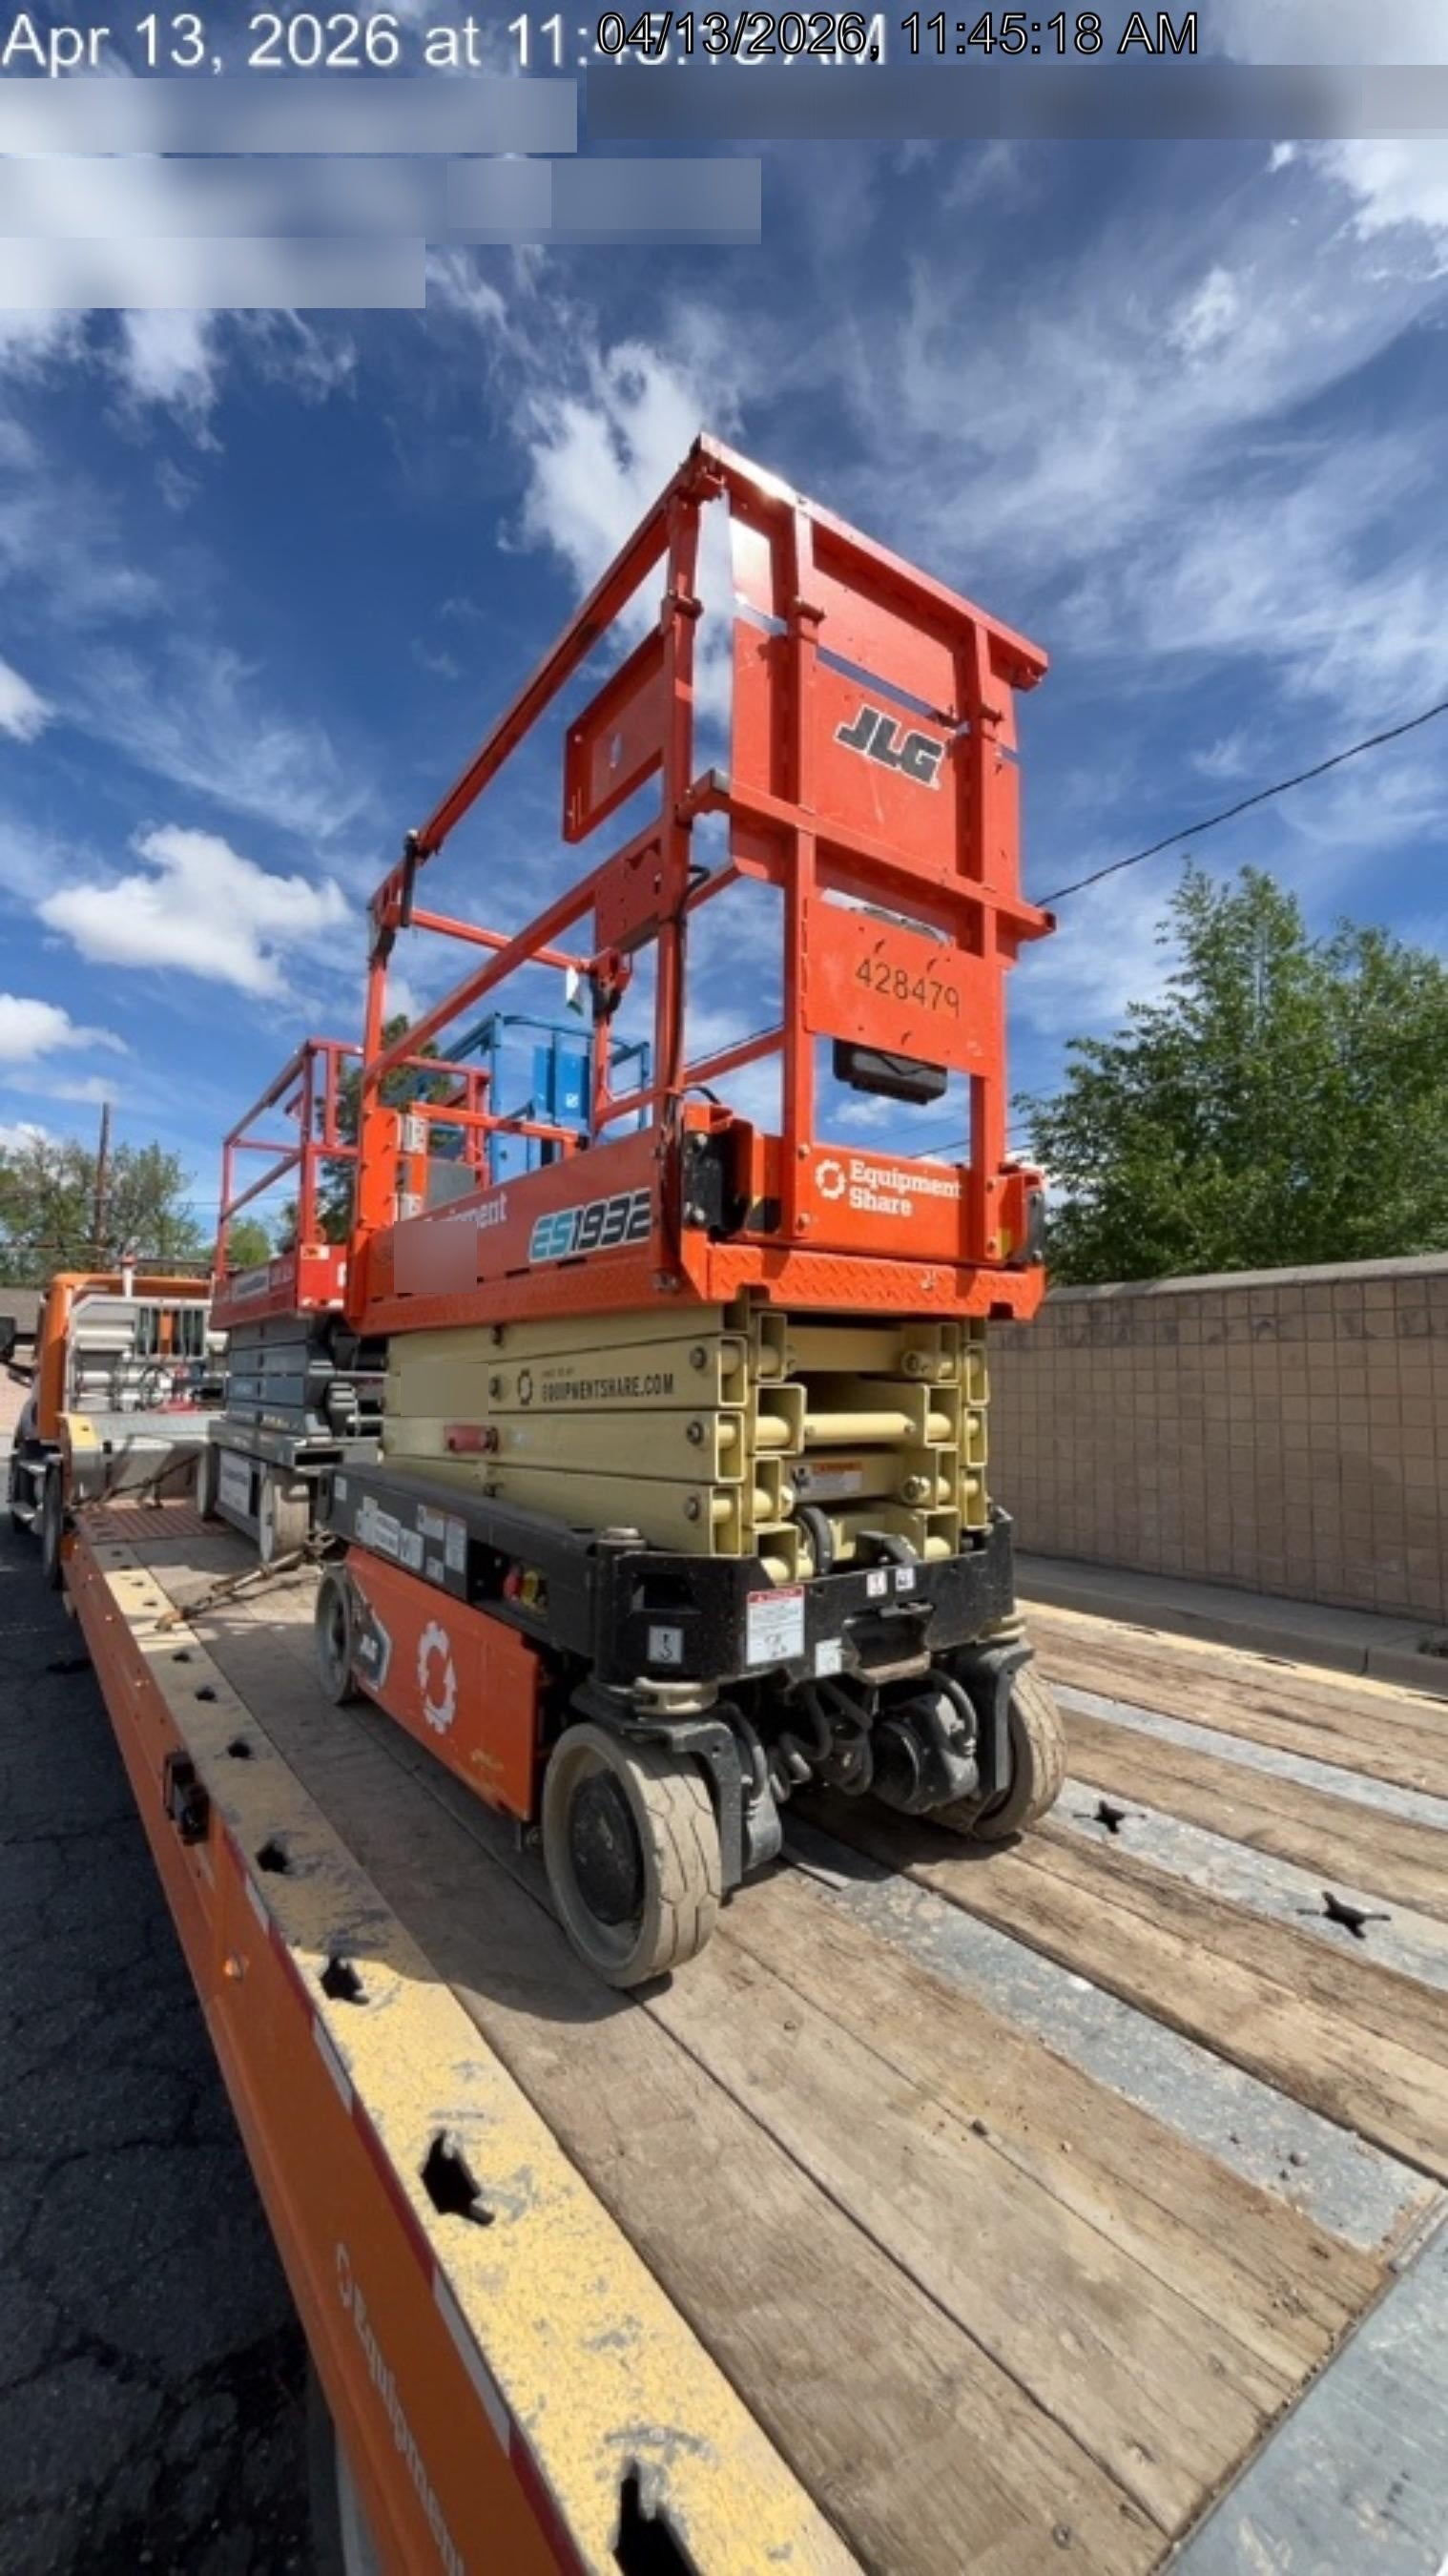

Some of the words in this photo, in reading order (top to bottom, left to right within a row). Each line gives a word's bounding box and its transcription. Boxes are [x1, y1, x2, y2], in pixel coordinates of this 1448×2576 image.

[833, 704, 944, 790] JLG
[855, 958, 960, 1018] 428479
[849, 1158, 961, 1199] Equipment
[849, 1185, 913, 1218] Share
